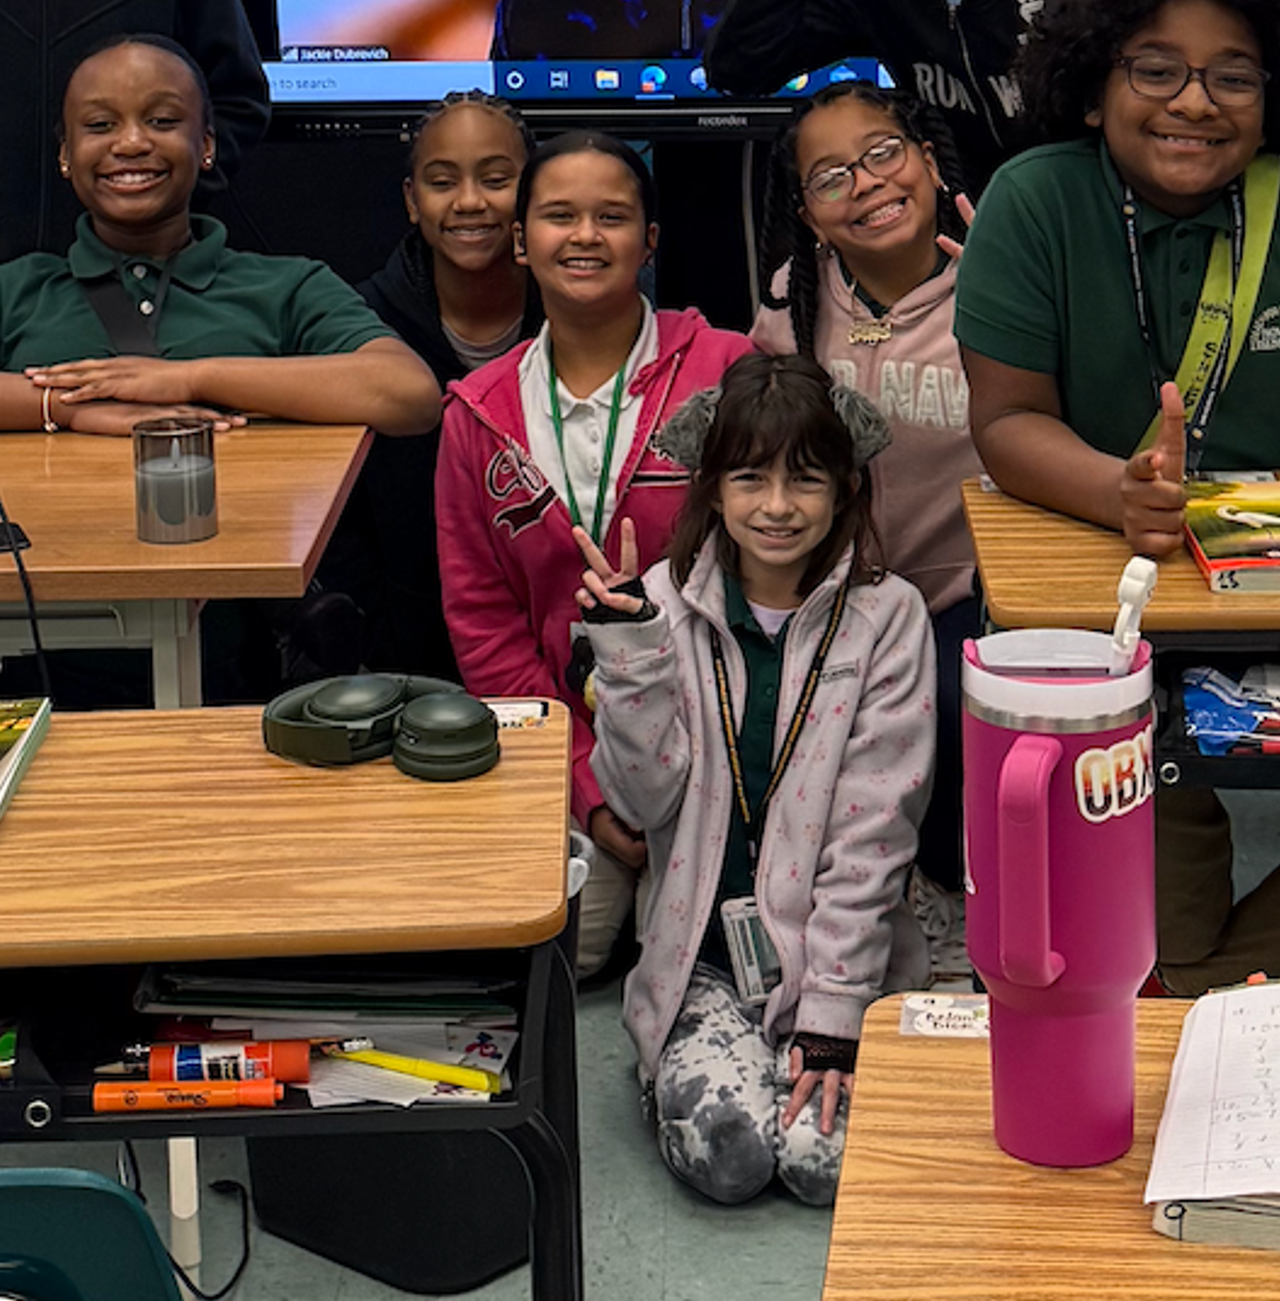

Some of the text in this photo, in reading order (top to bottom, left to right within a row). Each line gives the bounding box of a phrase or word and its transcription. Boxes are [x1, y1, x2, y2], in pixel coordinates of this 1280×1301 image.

[300, 48, 389, 60] Jackie Dubrovich
[279, 77, 338, 90] to search
[880, 360, 970, 429] NAV
[1163, 1201, 1187, 1242] 9
